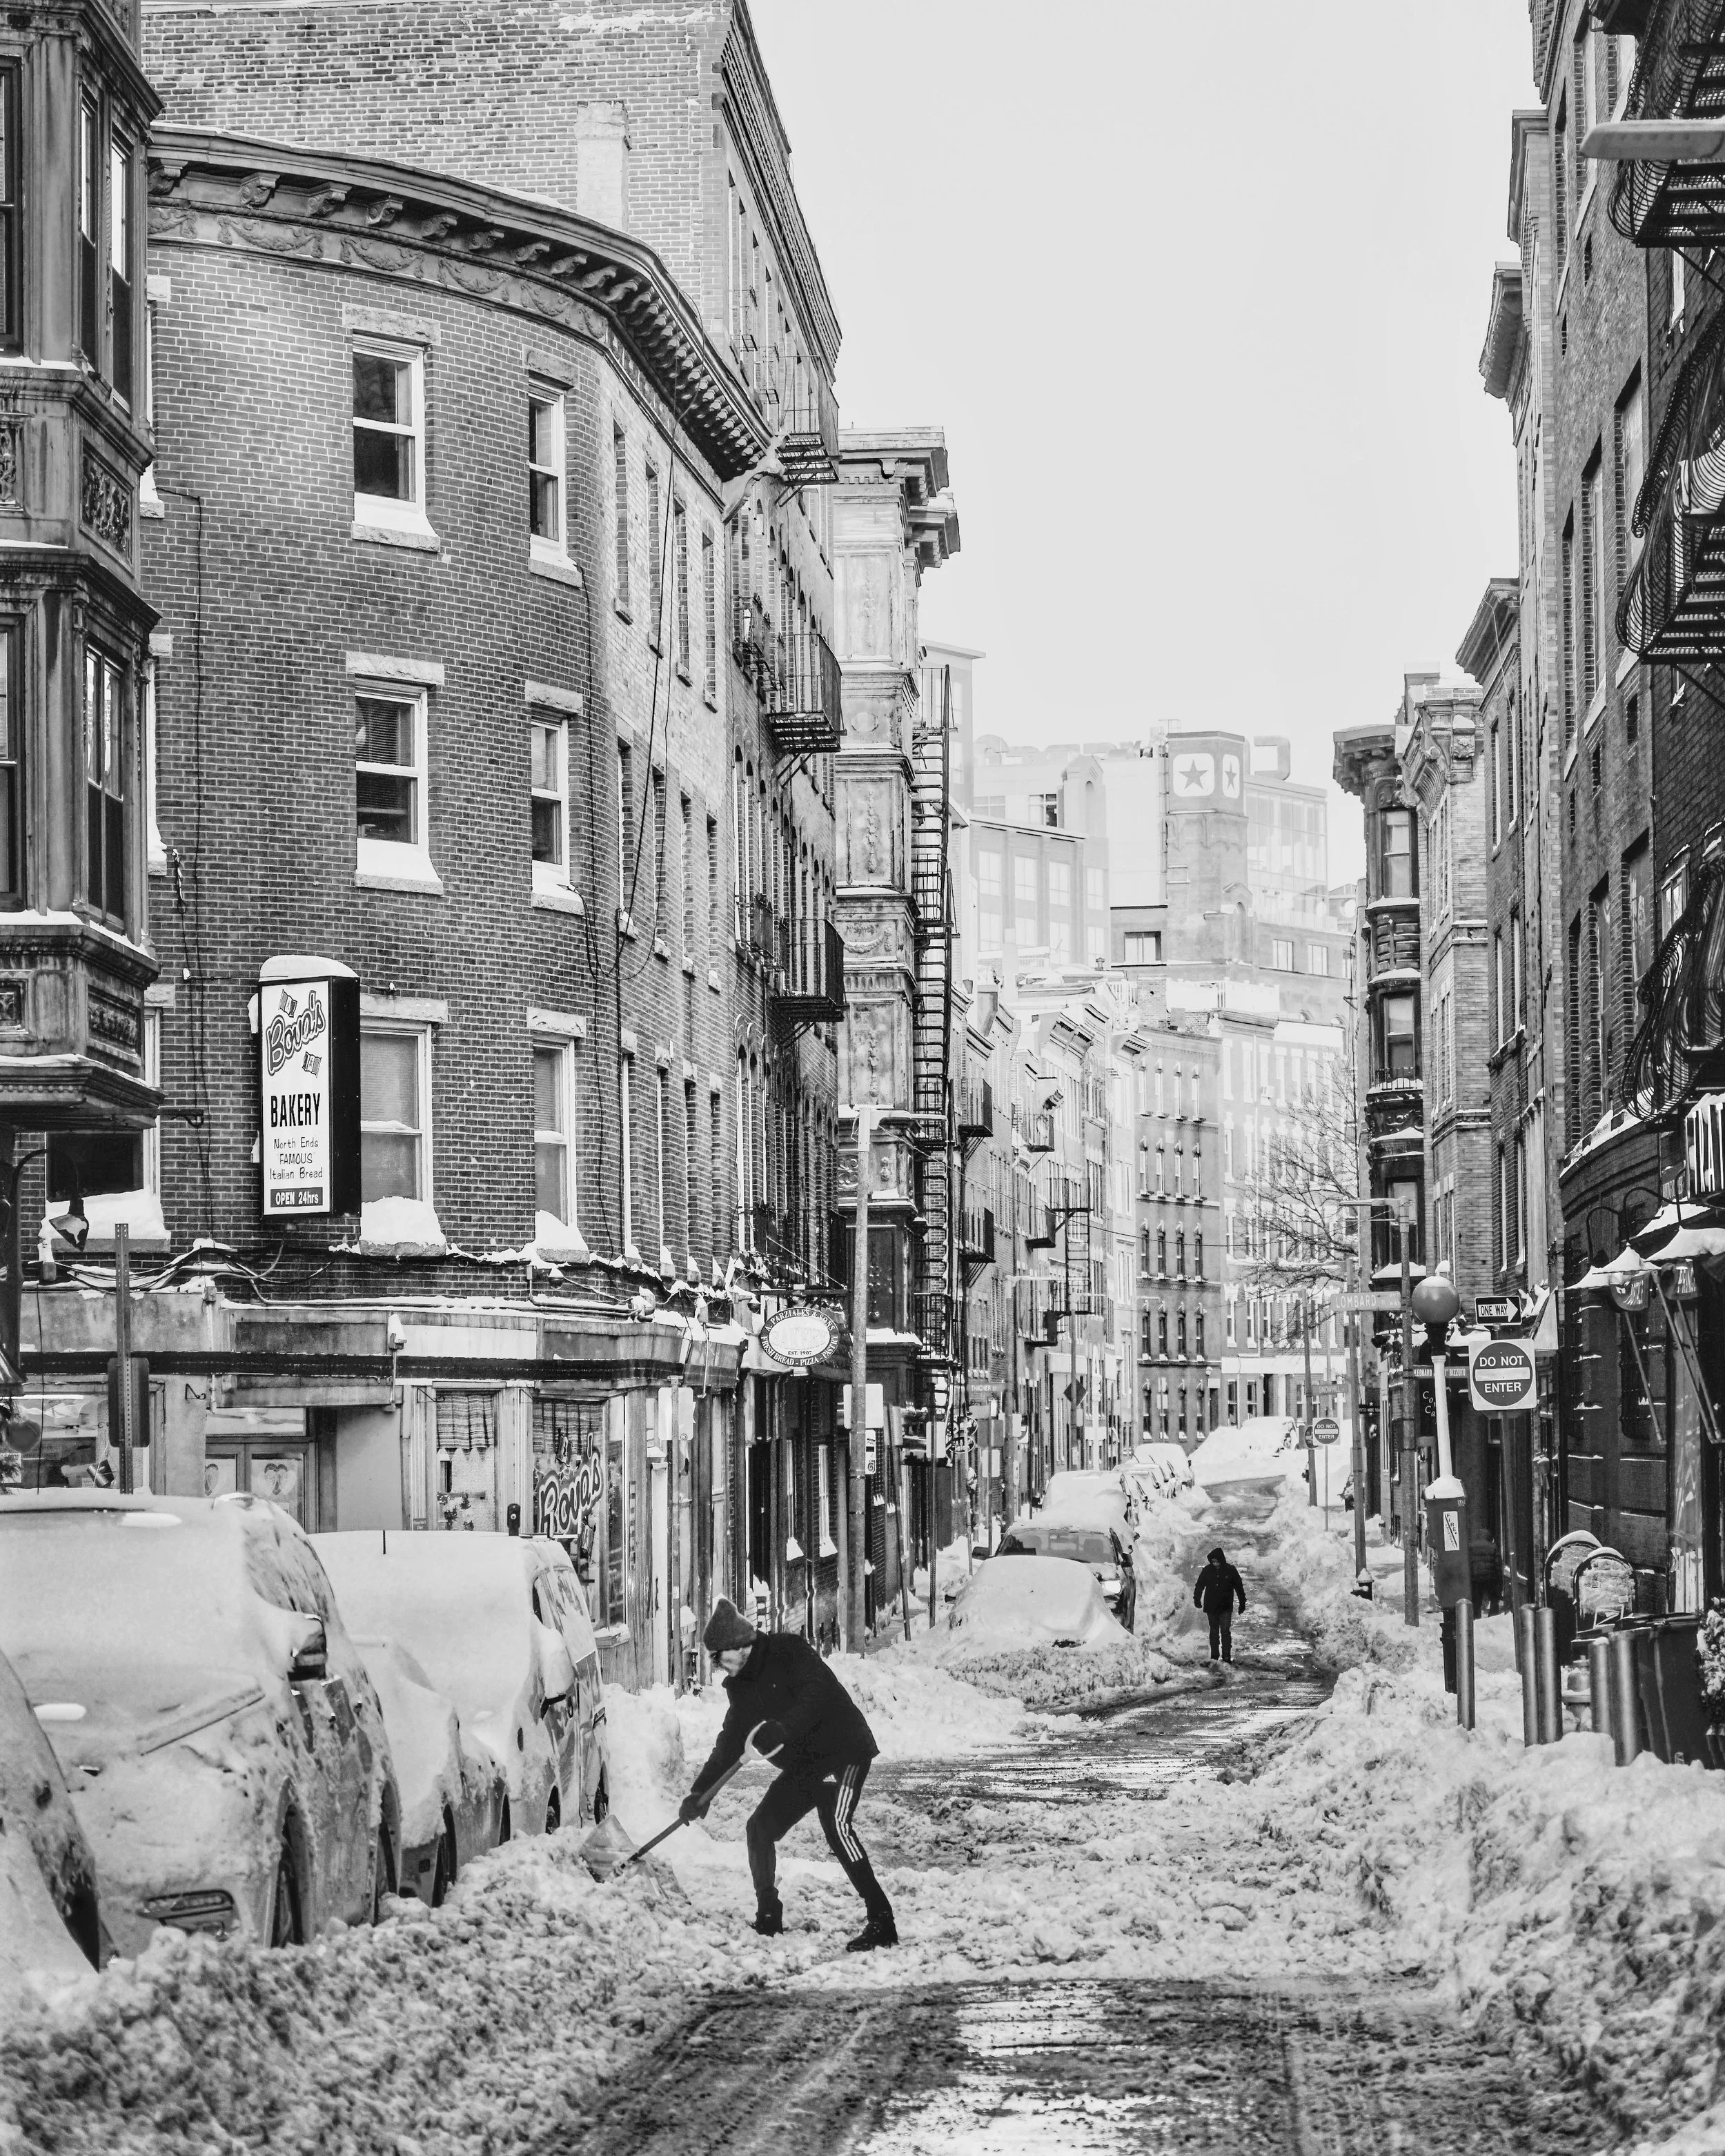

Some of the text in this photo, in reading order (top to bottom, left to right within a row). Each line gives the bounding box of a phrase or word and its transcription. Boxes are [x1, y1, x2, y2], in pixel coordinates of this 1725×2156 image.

[266, 990, 326, 1076] Bova's
[271, 1093, 320, 1127] BAKERY
[274, 1137, 318, 1149] North Ends
[279, 1153, 313, 1165] FAMOUS
[270, 1167, 322, 1180] Italian Bread
[276, 1191, 319, 1205] OPEN 24hrs
[1337, 1294, 1376, 1308] LOMBARD
[1481, 1305, 1508, 1316] ONE WAY
[819, 1314, 836, 1331] SONS
[761, 1335, 838, 1366] FRESH BREAD PIZZA PASTRY
[1479, 1356, 1524, 1367] DO NOT
[1484, 1382, 1521, 1393] ENTER
